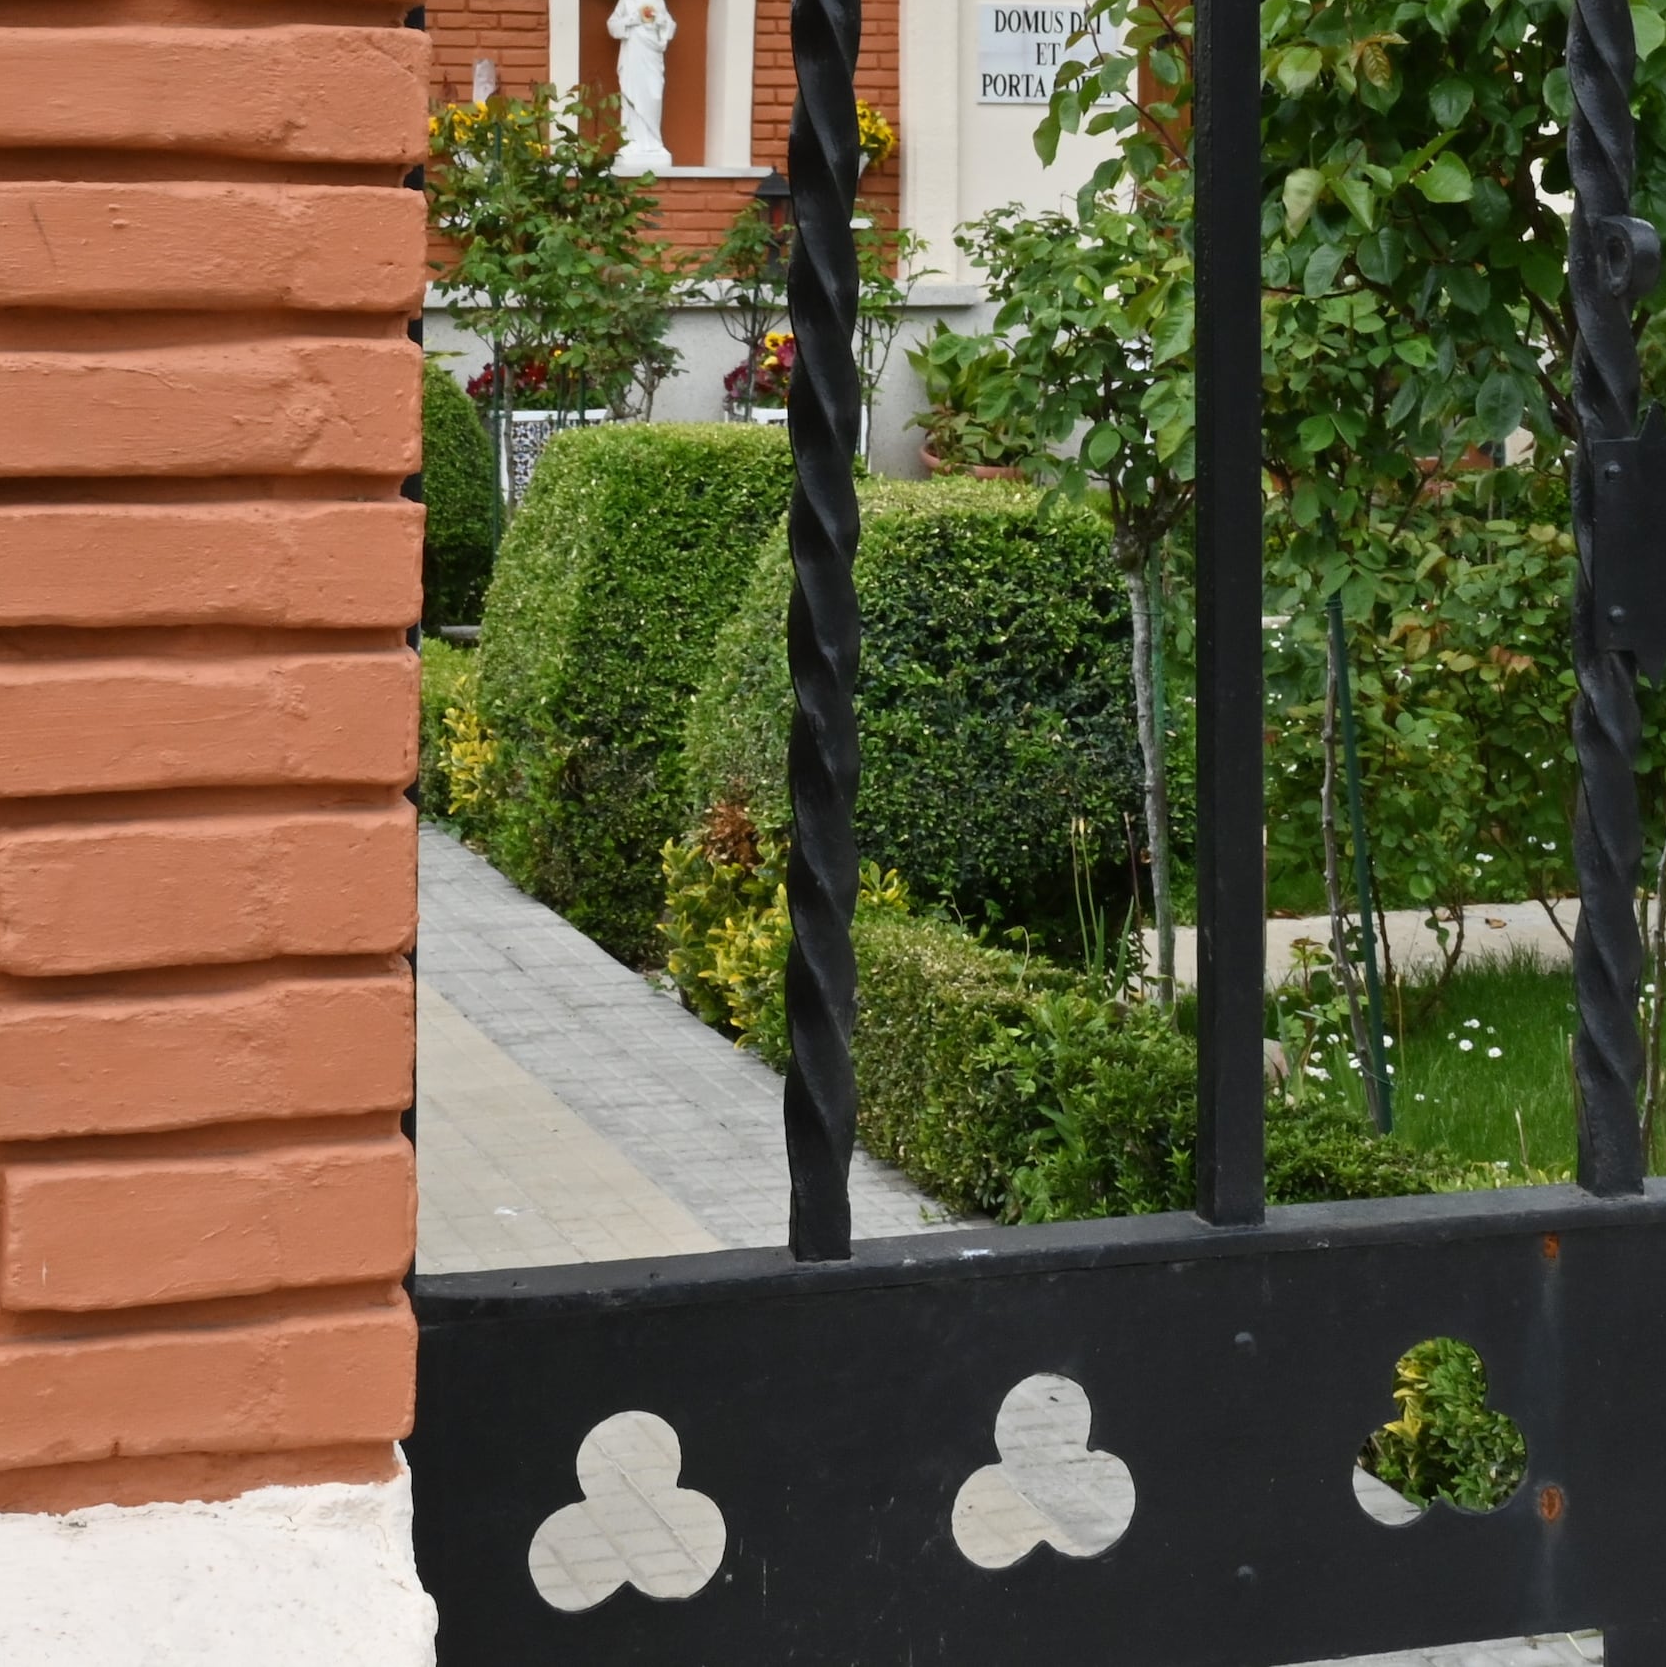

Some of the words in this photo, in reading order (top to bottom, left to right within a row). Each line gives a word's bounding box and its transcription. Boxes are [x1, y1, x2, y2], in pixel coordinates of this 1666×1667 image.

[994, 9, 1064, 34] DOMUS
[1036, 41, 1061, 66] ET
[982, 73, 1047, 98] PORTA
